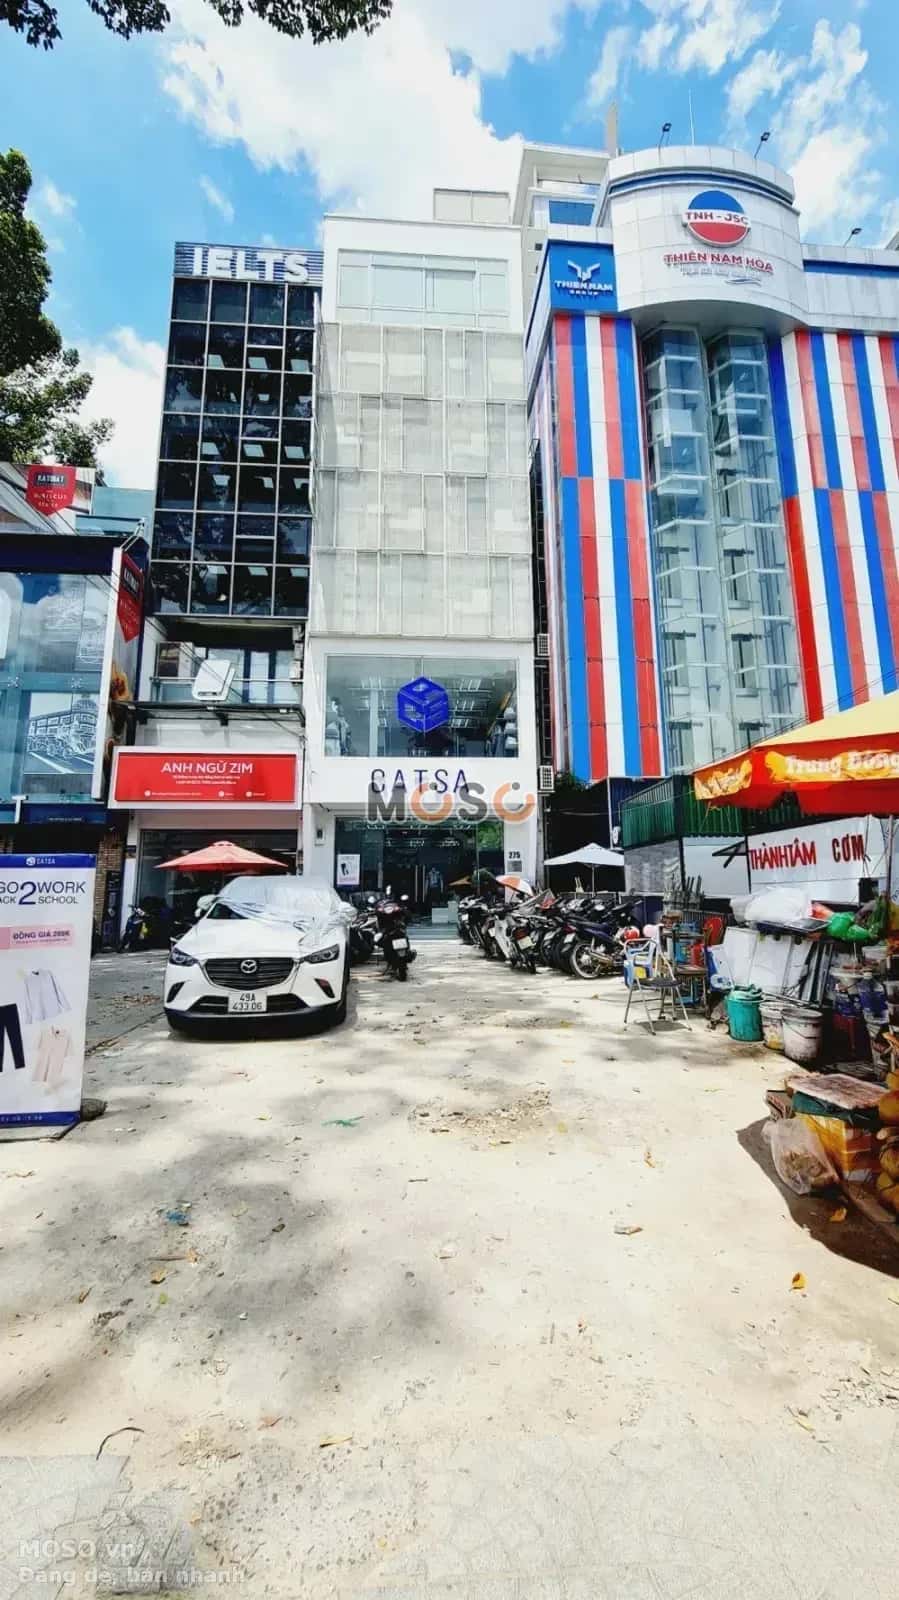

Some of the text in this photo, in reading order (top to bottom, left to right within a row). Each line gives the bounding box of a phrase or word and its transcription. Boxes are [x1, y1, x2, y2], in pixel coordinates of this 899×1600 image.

[684, 211, 714, 220] TNH
[724, 213, 749, 226] JSC
[193, 246, 309, 284] IELTS
[711, 253, 743, 266] NAM
[161, 762, 193, 774] ANH
[229, 762, 253, 774] ZIM
[370, 768, 470, 794] CATSA
[831, 833, 865, 863] CƠM
[0, 895, 79, 905] CK SCHOOL
[18, 881, 37, 905] 2
[37, 881, 86, 894] WORK
[240, 993, 256, 1001] 49A
